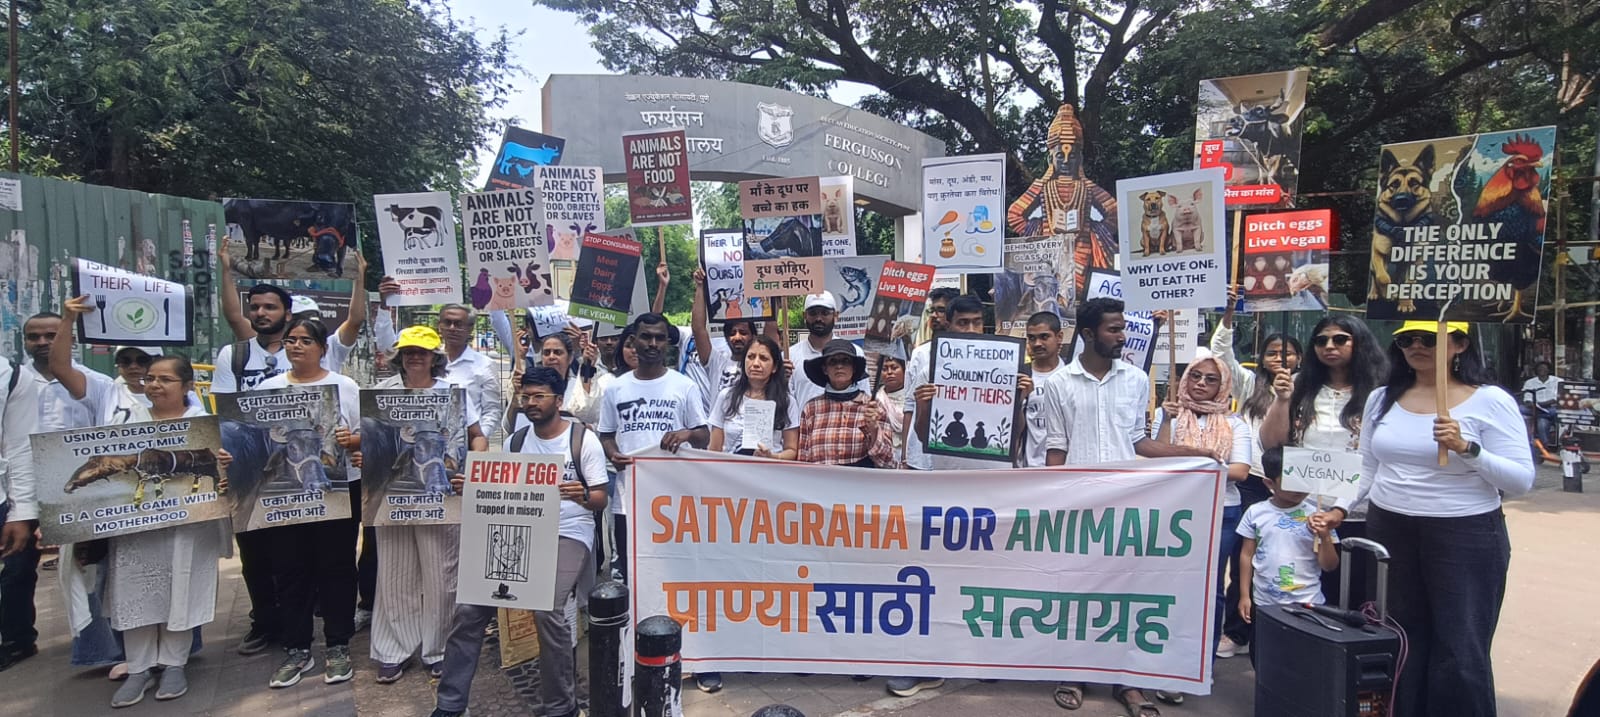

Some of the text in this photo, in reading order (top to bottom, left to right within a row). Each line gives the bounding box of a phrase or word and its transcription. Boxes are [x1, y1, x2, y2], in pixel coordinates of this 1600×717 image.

[843, 121, 874, 137] EDUCATION
[630, 135, 682, 155] ANIMALS
[824, 132, 903, 171] FERGUSSON
[632, 151, 682, 170] ARE NOT
[540, 168, 597, 181] ANIMALS
[644, 168, 676, 185] FOOD
[543, 180, 595, 192] ARE NOT
[749, 182, 809, 200] माँ के दूध पर
[467, 190, 535, 211] ANIMALS
[541, 192, 600, 204] PROPERTY,
[567, 203, 601, 212] OBJECTS
[752, 200, 810, 214] बच्चे का हक
[472, 207, 534, 226] ARE NOT
[546, 212, 595, 221] OR SLAVES
[470, 222, 541, 240] PROPERTY,
[1248, 219, 1324, 233] Ditch eggs
[1403, 221, 1504, 243] THE ONLY
[472, 236, 543, 252] FOOD, OBJECTS
[584, 235, 602, 245] STOP
[821, 239, 833, 247] OVE
[1036, 241, 1063, 249] EVERY
[1248, 234, 1327, 248] Live Vegan
[479, 248, 537, 262] OR SLAVES
[832, 248, 845, 256] THE
[1014, 253, 1040, 262] GLASS
[1390, 242, 1518, 263] DIFFERENCE
[596, 255, 618, 267] Meat
[1024, 264, 1044, 272] MILK
[1127, 259, 1218, 275] WHY LOVE ONE,
[593, 267, 616, 280] Dairy
[756, 264, 772, 279] दूध
[882, 266, 906, 279] Ditch
[906, 270, 929, 283] eggs
[1409, 263, 1491, 281] IS YOUR
[90, 274, 173, 294] THEIR LIFE
[753, 279, 780, 291] वीगन
[1139, 273, 1207, 287] BUT EAT THE
[878, 281, 927, 298] Live Vegan
[1151, 288, 1195, 300] OTHER?
[1386, 283, 1513, 300] PERCEPTION
[578, 307, 616, 322] BE VEGAN
[940, 340, 1014, 361] OUR FREEDOM
[990, 367, 1015, 385] COST
[286, 391, 321, 407] प्रत्येक
[935, 384, 1012, 405] THEM THEIRS
[649, 399, 677, 409] PUNE
[638, 411, 674, 421] ANIMAL
[63, 421, 191, 444] USING A DEAD CALF
[72, 436, 186, 457] TO EXTRACT MILK
[1312, 451, 1331, 463] GO
[470, 460, 558, 486] EVERY EGG
[1297, 464, 1344, 482] VEGAN
[262, 490, 323, 507] एका मातेचे
[388, 490, 444, 506] एका मातेचे
[476, 489, 545, 502] Comes from a hen
[60, 492, 218, 525] IS A CRUEL GAME WITH
[266, 504, 326, 523] शोषण आहे
[390, 505, 445, 522] शोषण आहे
[476, 503, 545, 518] trapped in misery.
[94, 510, 188, 534] MOTHERHOOD
[650, 495, 1193, 558] SATYAGRAHA FOR ANIMALS
[960, 585, 1177, 654] सत्याग्रह
